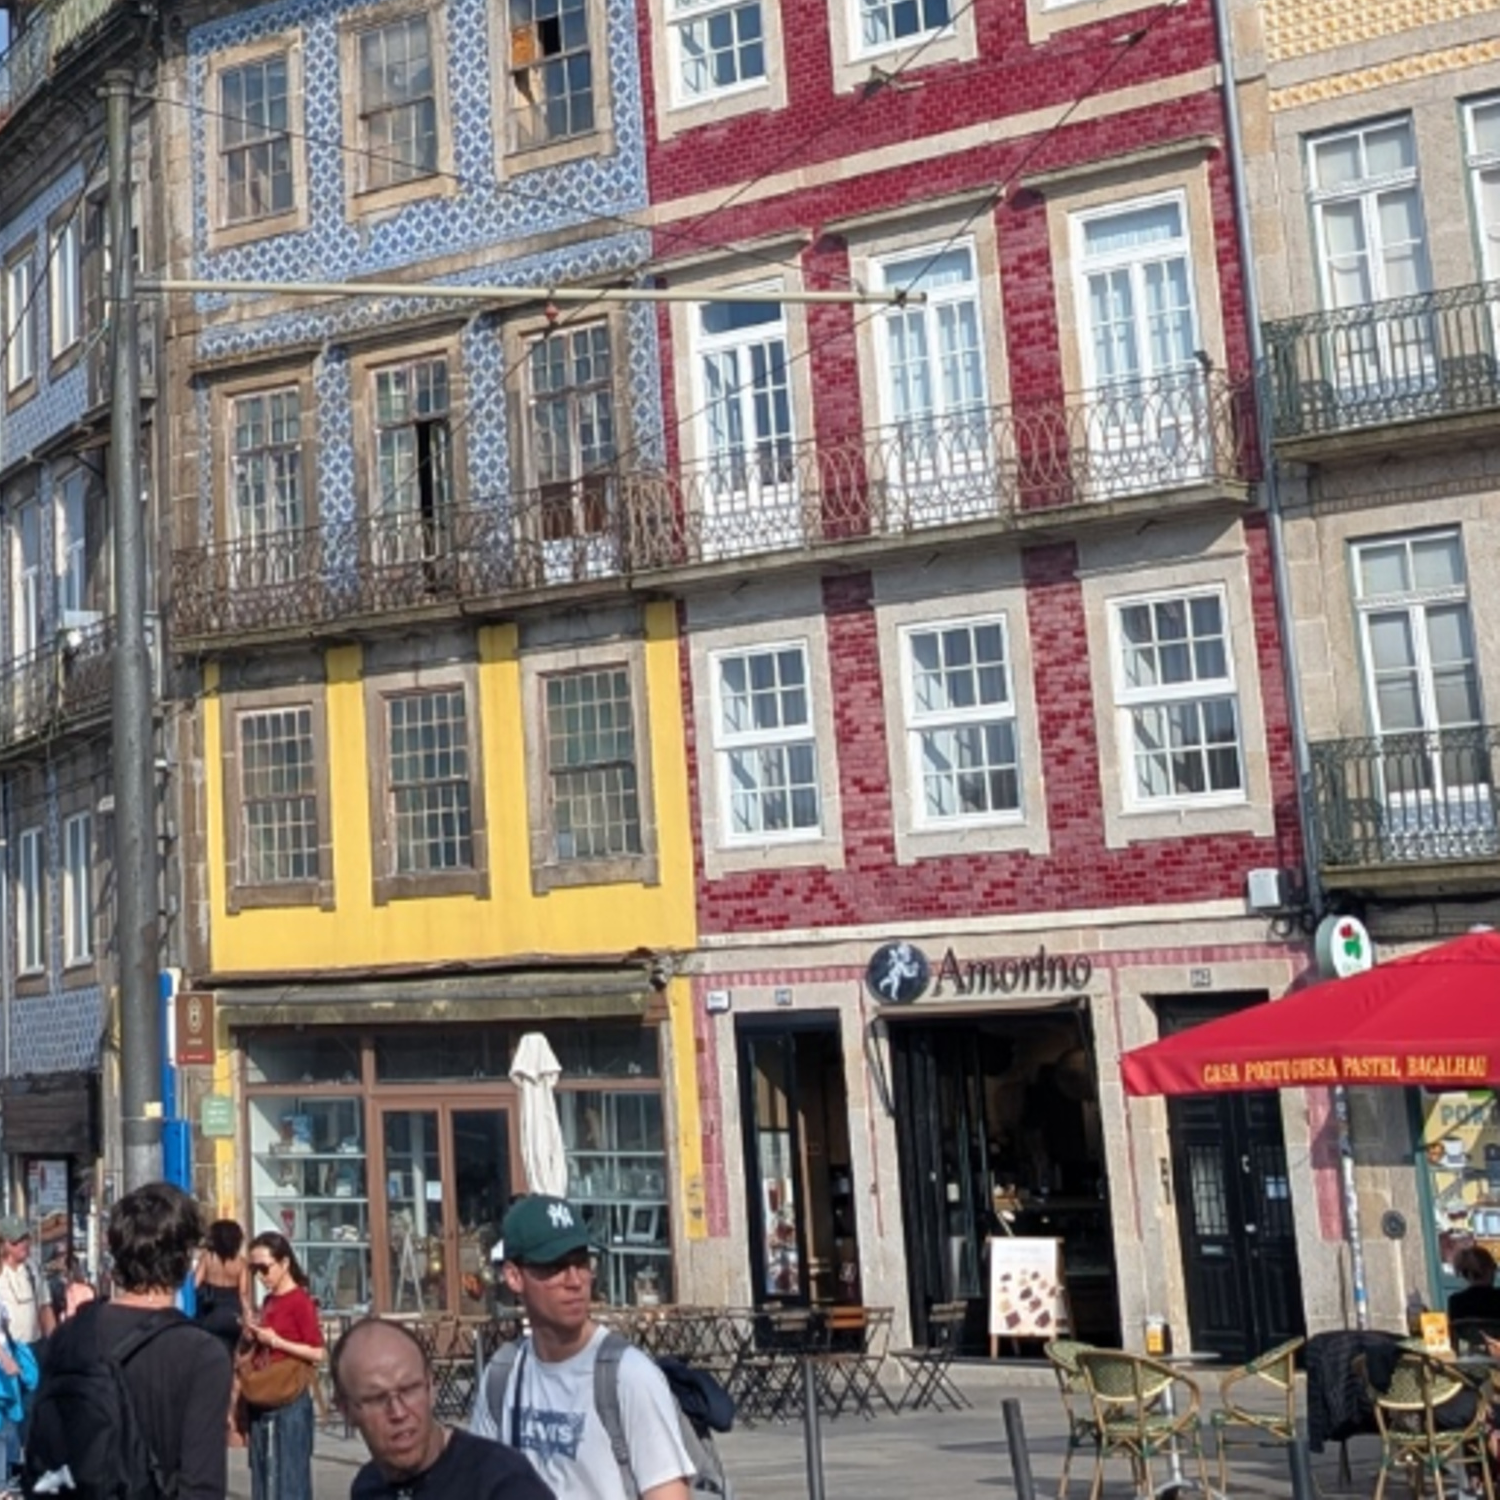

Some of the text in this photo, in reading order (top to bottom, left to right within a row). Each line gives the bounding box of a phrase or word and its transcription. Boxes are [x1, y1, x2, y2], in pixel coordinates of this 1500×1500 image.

[932, 944, 1092, 997] Amorino
[1204, 1062, 1240, 1082] CASA
[1244, 1057, 1337, 1082] PORTUGUESA
